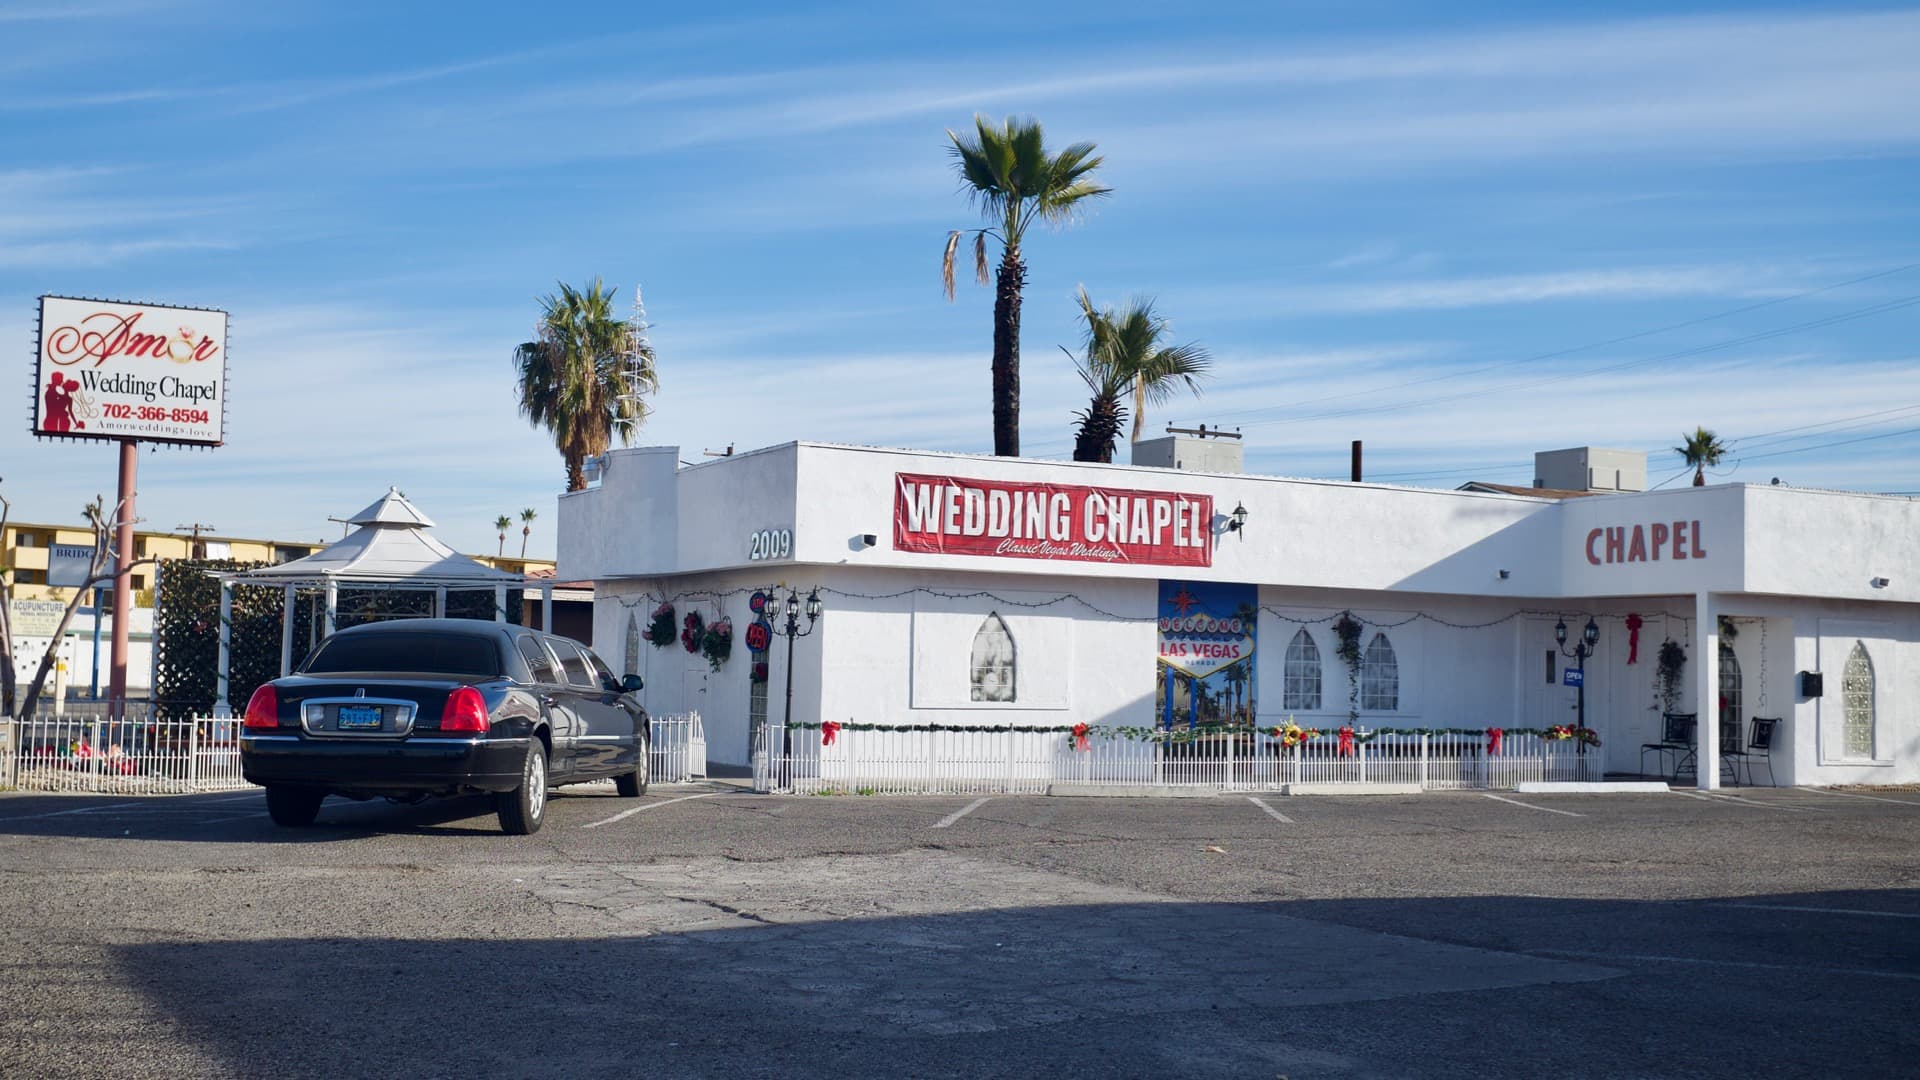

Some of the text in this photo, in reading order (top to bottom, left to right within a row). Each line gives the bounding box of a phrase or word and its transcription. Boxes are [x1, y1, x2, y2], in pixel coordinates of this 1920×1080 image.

[80, 370, 217, 405] Wedding Chapel
[102, 403, 209, 424] 702-366-8594
[96, 420, 213, 437] Amorweddings.love
[905, 482, 1205, 548] WEDDING CHAPEL
[751, 529, 792, 560] 2009
[996, 538, 1121, 561] Classic Vegas Weddings
[1585, 520, 1707, 566] CHAPEL
[56, 548, 109, 560] BRIDG
[13, 601, 64, 612] ACUPUNCTURE
[1160, 618, 1241, 632] WELCOME
[1160, 642, 1240, 659] LAS VEGAS
